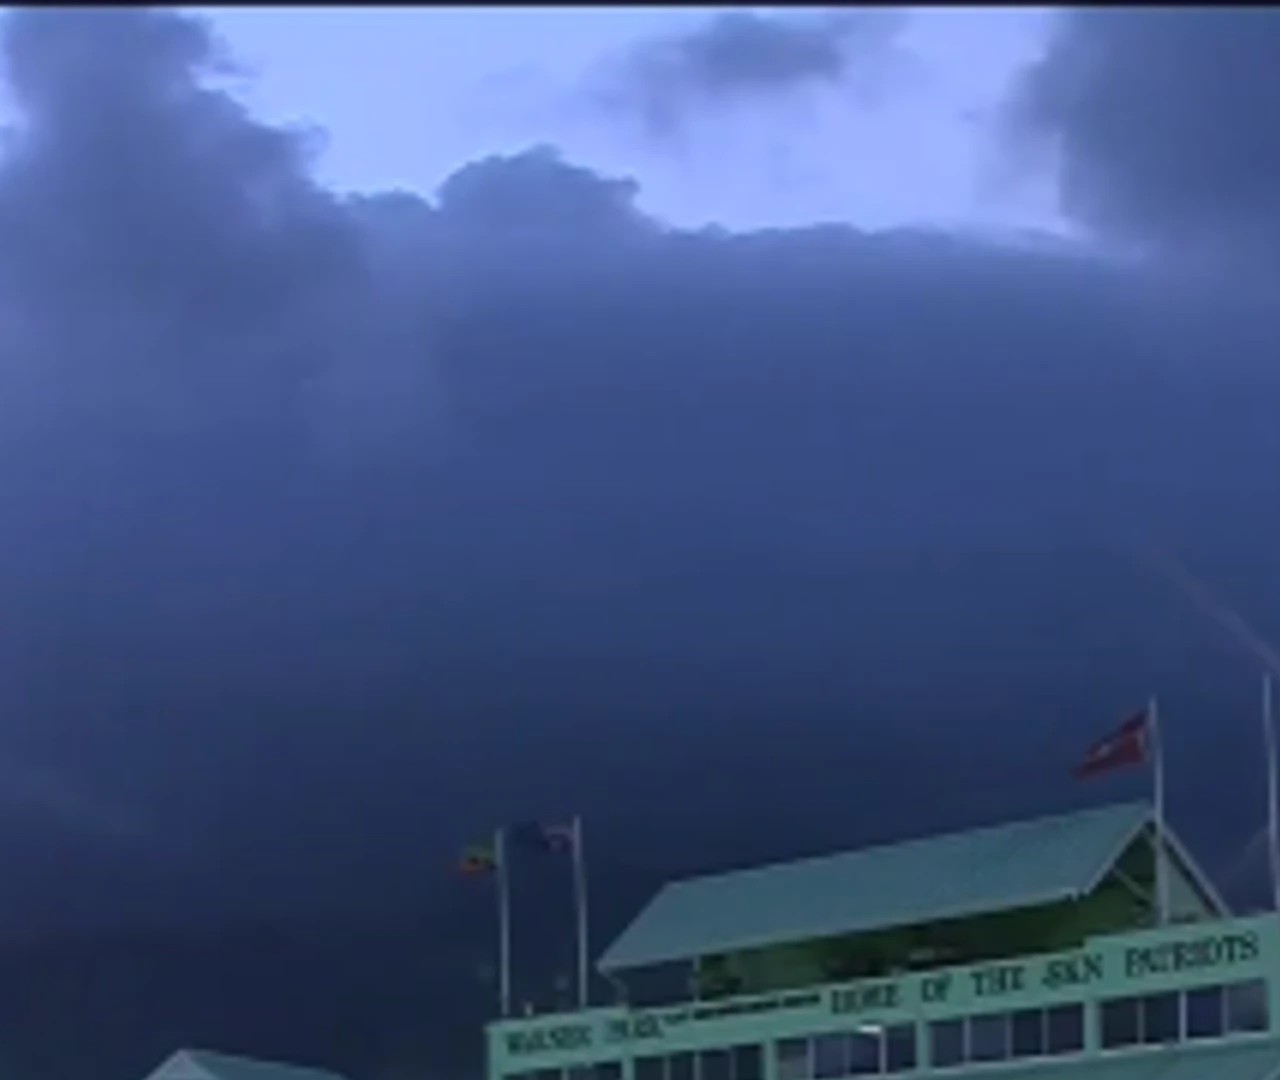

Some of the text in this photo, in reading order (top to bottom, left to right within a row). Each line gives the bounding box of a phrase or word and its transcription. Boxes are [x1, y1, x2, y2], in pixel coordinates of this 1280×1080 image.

[830, 984, 899, 1015] HOME
[920, 971, 952, 1002] OF
[969, 964, 1023, 996] THE
[1125, 931, 1260, 978] PATRIOTS
